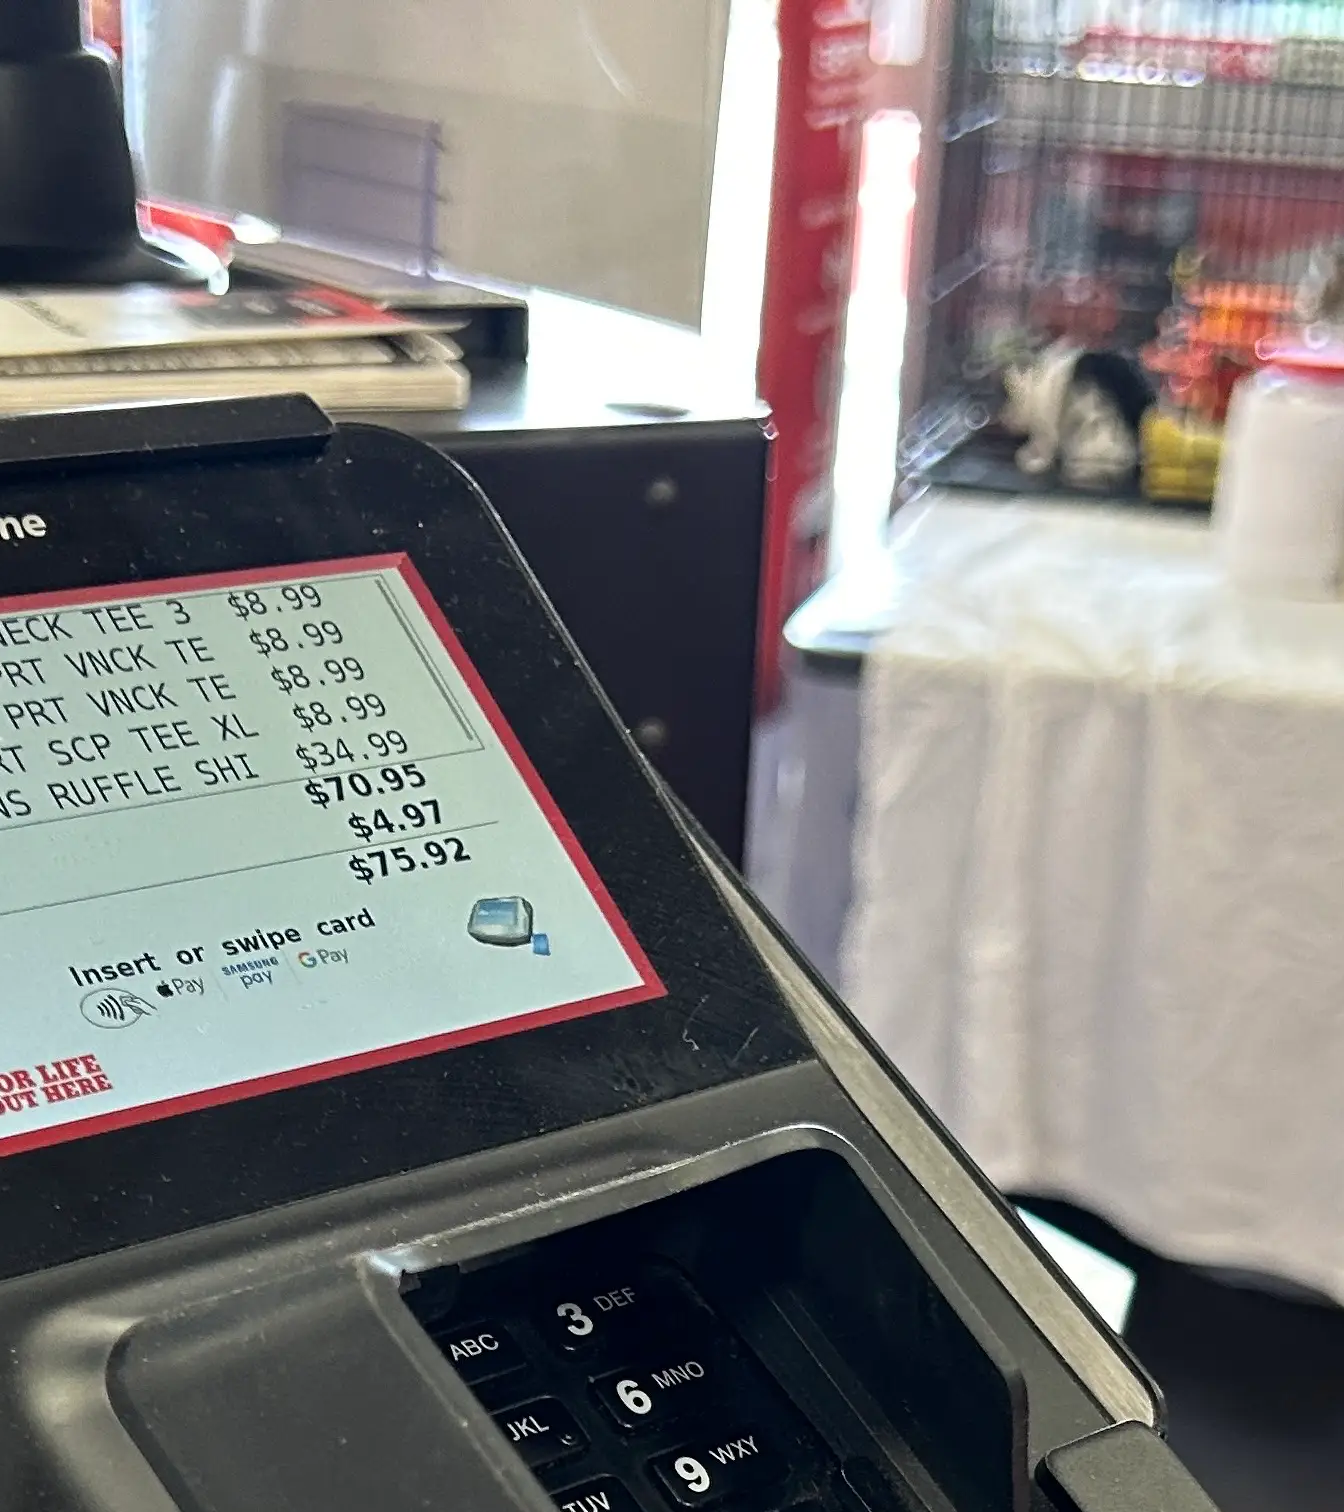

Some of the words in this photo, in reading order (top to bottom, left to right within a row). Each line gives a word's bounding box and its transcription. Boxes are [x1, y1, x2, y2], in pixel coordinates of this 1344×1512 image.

[82, 602, 154, 636] TEE
[165, 599, 192, 625] 3
[226, 583, 323, 622] $8.99
[64, 645, 158, 681] VNCK
[164, 636, 216, 666] TE
[248, 619, 344, 658] $8.99
[2, 696, 70, 730] PRT
[85, 682, 180, 718] VNCK
[186, 674, 237, 703] TE
[270, 656, 366, 695] $8.99
[47, 733, 112, 767] SCP
[127, 720, 200, 756] TEE
[210, 713, 260, 742] XL
[291, 692, 388, 732] $8.99
[47, 765, 182, 812] RUFFLE
[194, 753, 260, 785] SHI
[294, 729, 409, 774] $34.99
[304, 763, 426, 809] $70.95
[348, 798, 443, 843] $4.97
[348, 836, 471, 885] $75.92
[69, 951, 161, 988] Insert
[175, 943, 205, 966] or
[221, 925, 303, 958] swipe
[316, 907, 376, 937] card
[220, 955, 280, 977] SAMSUNG
[316, 947, 350, 965] Pay
[171, 976, 205, 997] Pay
[239, 968, 274, 990] pay
[34, 1053, 103, 1084] LIFE
[40, 1074, 114, 1104] HERE
[556, 1302, 594, 1336] 3
[593, 1287, 636, 1312] DEF
[449, 1333, 500, 1363] ABC
[615, 1379, 653, 1415] 6
[651, 1361, 705, 1389] MNO
[506, 1415, 550, 1443] JKL
[673, 1456, 712, 1493] 9
[708, 1435, 759, 1465] WXY
